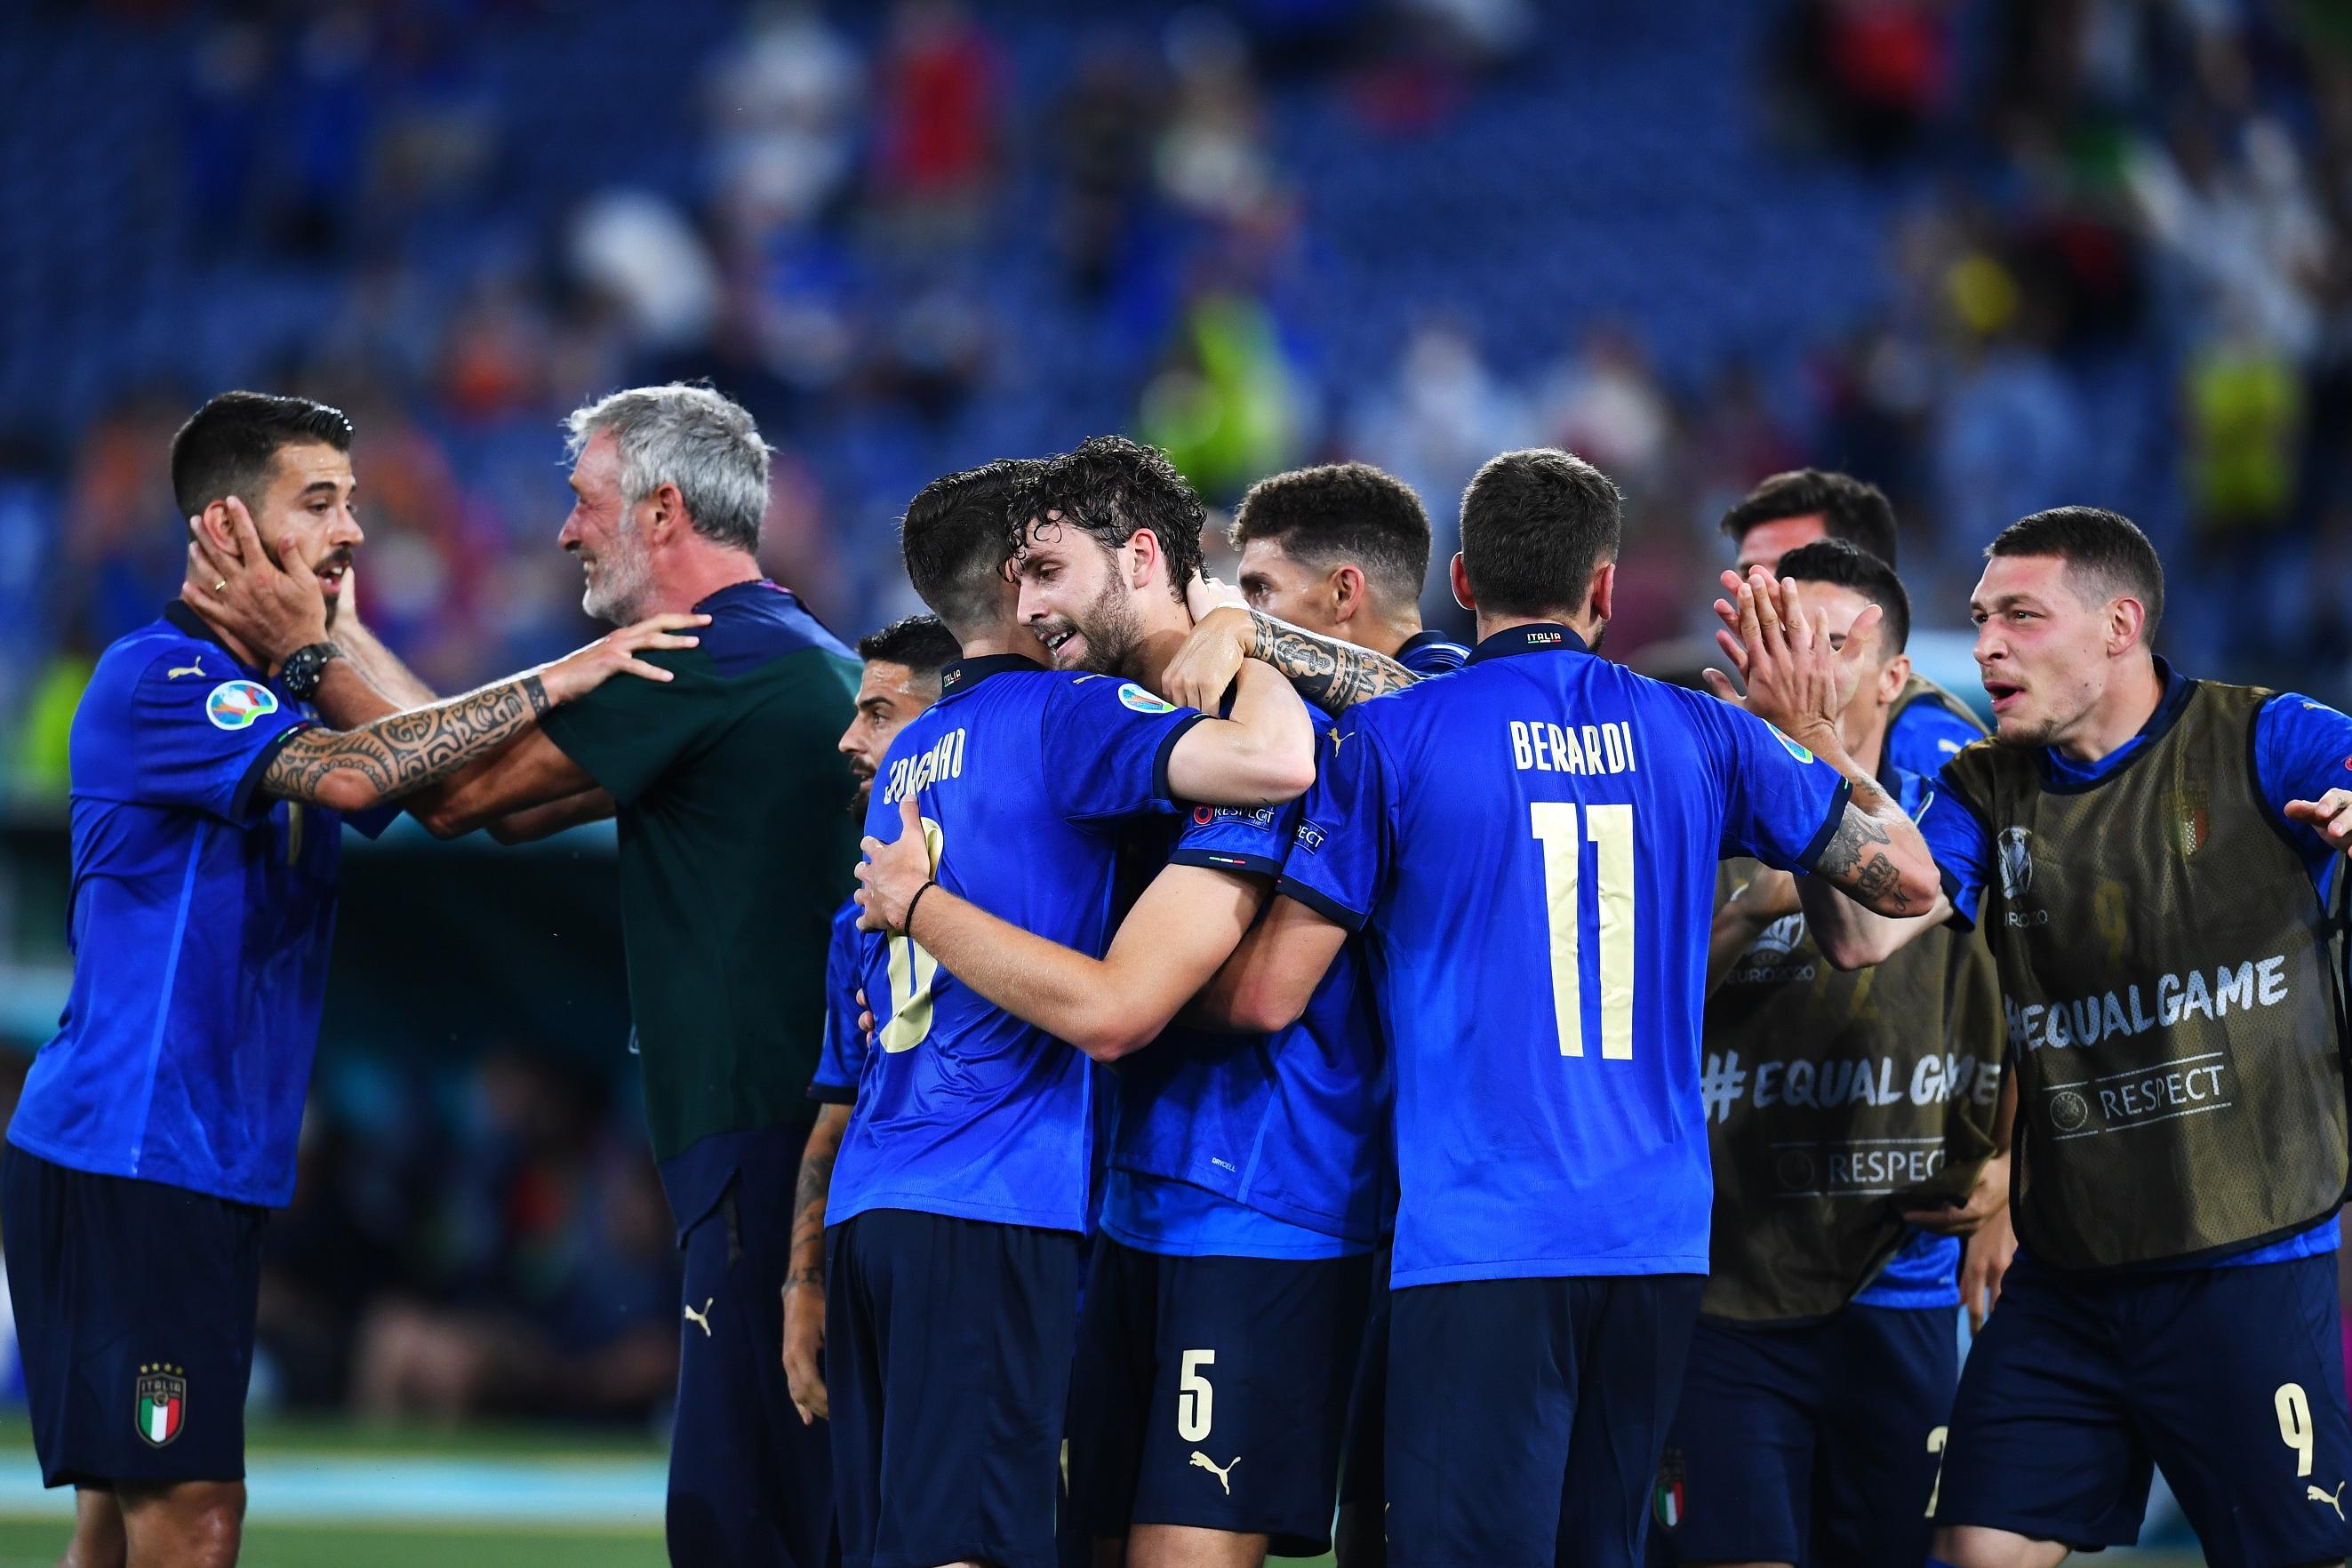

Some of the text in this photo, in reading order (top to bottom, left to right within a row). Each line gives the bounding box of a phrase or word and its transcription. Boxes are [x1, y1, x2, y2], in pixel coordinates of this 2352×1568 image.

[1527, 632, 1562, 641] ITALIA
[1509, 721, 1636, 776] BERARDI
[1530, 802, 1636, 1060] 11
[2100, 1065, 2225, 1120] RESPECT
[1178, 1349, 1215, 1442] 5
[2275, 1382, 2314, 1477] 9
